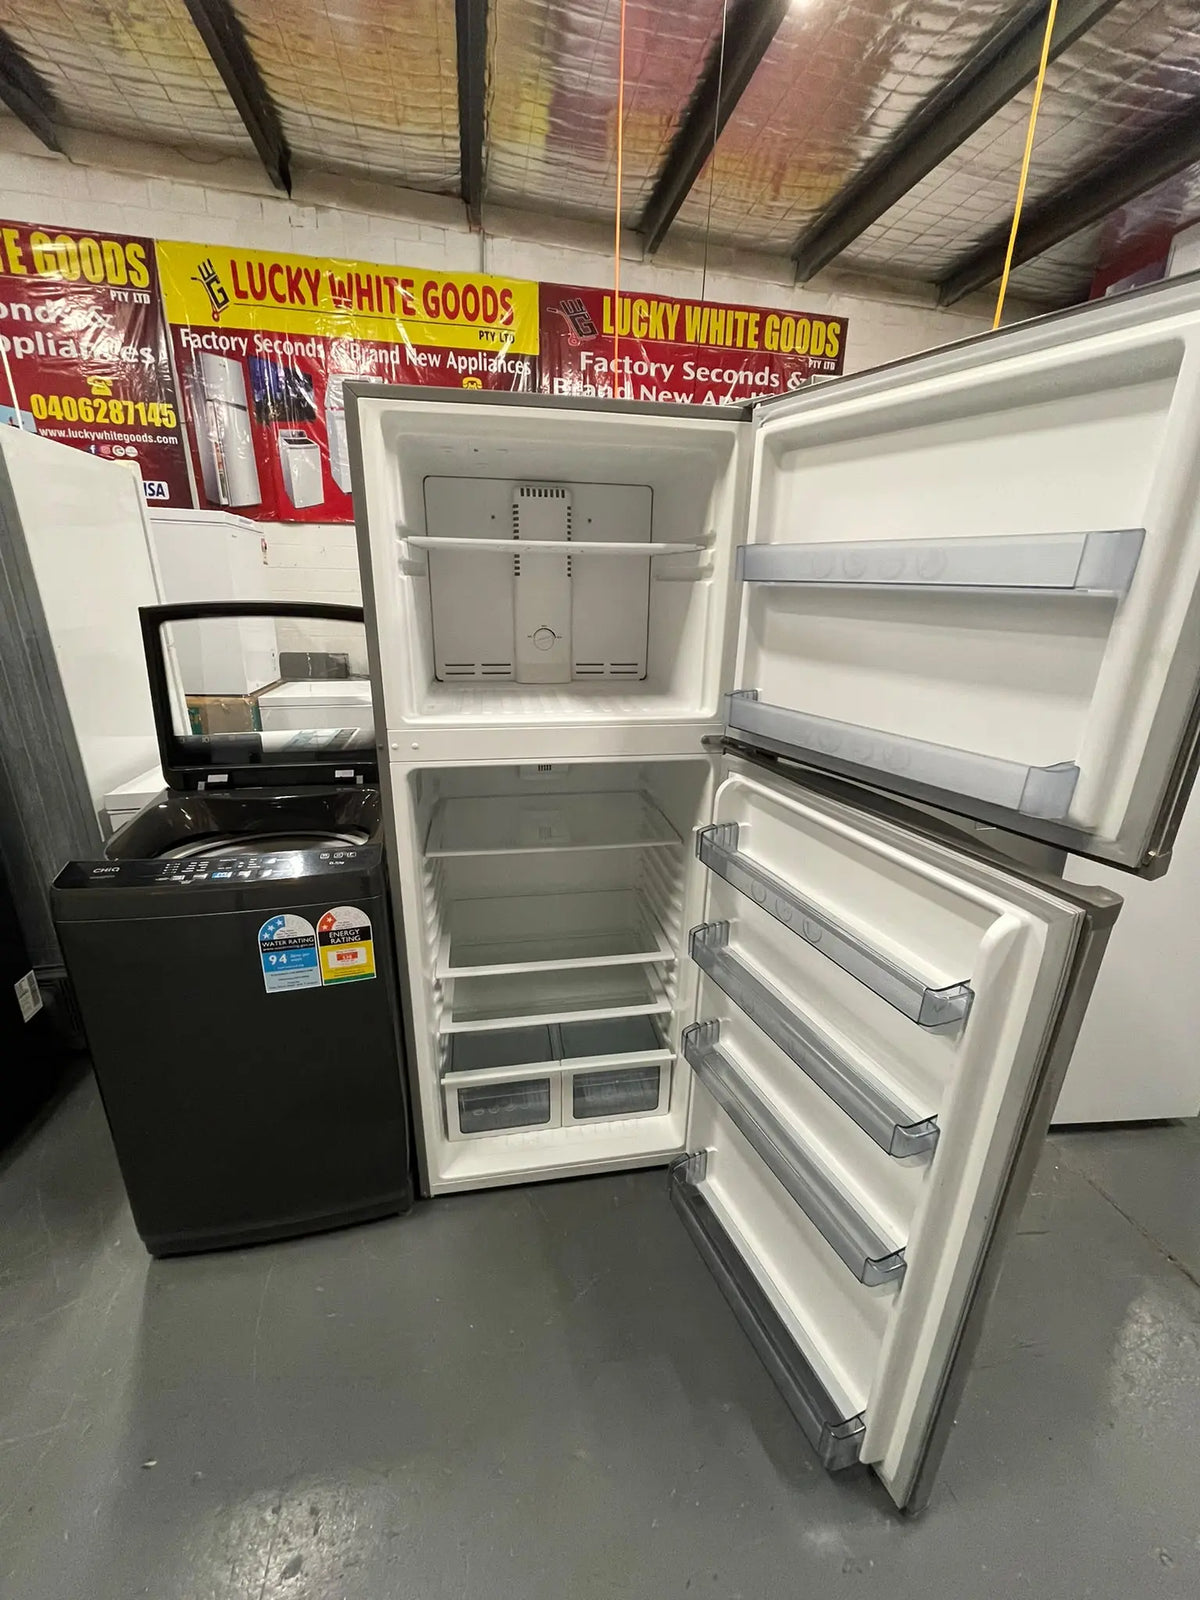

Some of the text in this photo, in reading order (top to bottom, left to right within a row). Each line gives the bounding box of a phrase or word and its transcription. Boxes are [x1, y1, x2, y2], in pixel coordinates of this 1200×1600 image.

[30, 231, 150, 288] GOODS
[110, 290, 151, 305] PTY LTD
[230, 260, 514, 326] LUCKY WHITE GOODS
[602, 296, 841, 358] LUCKY WHITE GOODS
[478, 330, 516, 344] PTY LTD
[180, 328, 247, 357] Factory
[253, 334, 324, 359] Seconds
[350, 342, 400, 366] Brand
[406, 347, 441, 368] New
[447, 351, 532, 377] Appliances
[579, 351, 807, 391] Factory Seconds &
[808, 360, 836, 371] PTY LTD
[553, 376, 633, 400] Brand
[640, 384, 694, 404] New
[30, 394, 177, 428] 0406287145
[38, 428, 179, 445] www.luckywhitegoods.com
[143, 482, 166, 497] ISA
[328, 928, 360, 939] ENERGY
[330, 935, 361, 944] RATING
[261, 940, 287, 948] WATER
[288, 936, 314, 945] RATING
[268, 953, 288, 966] 94
